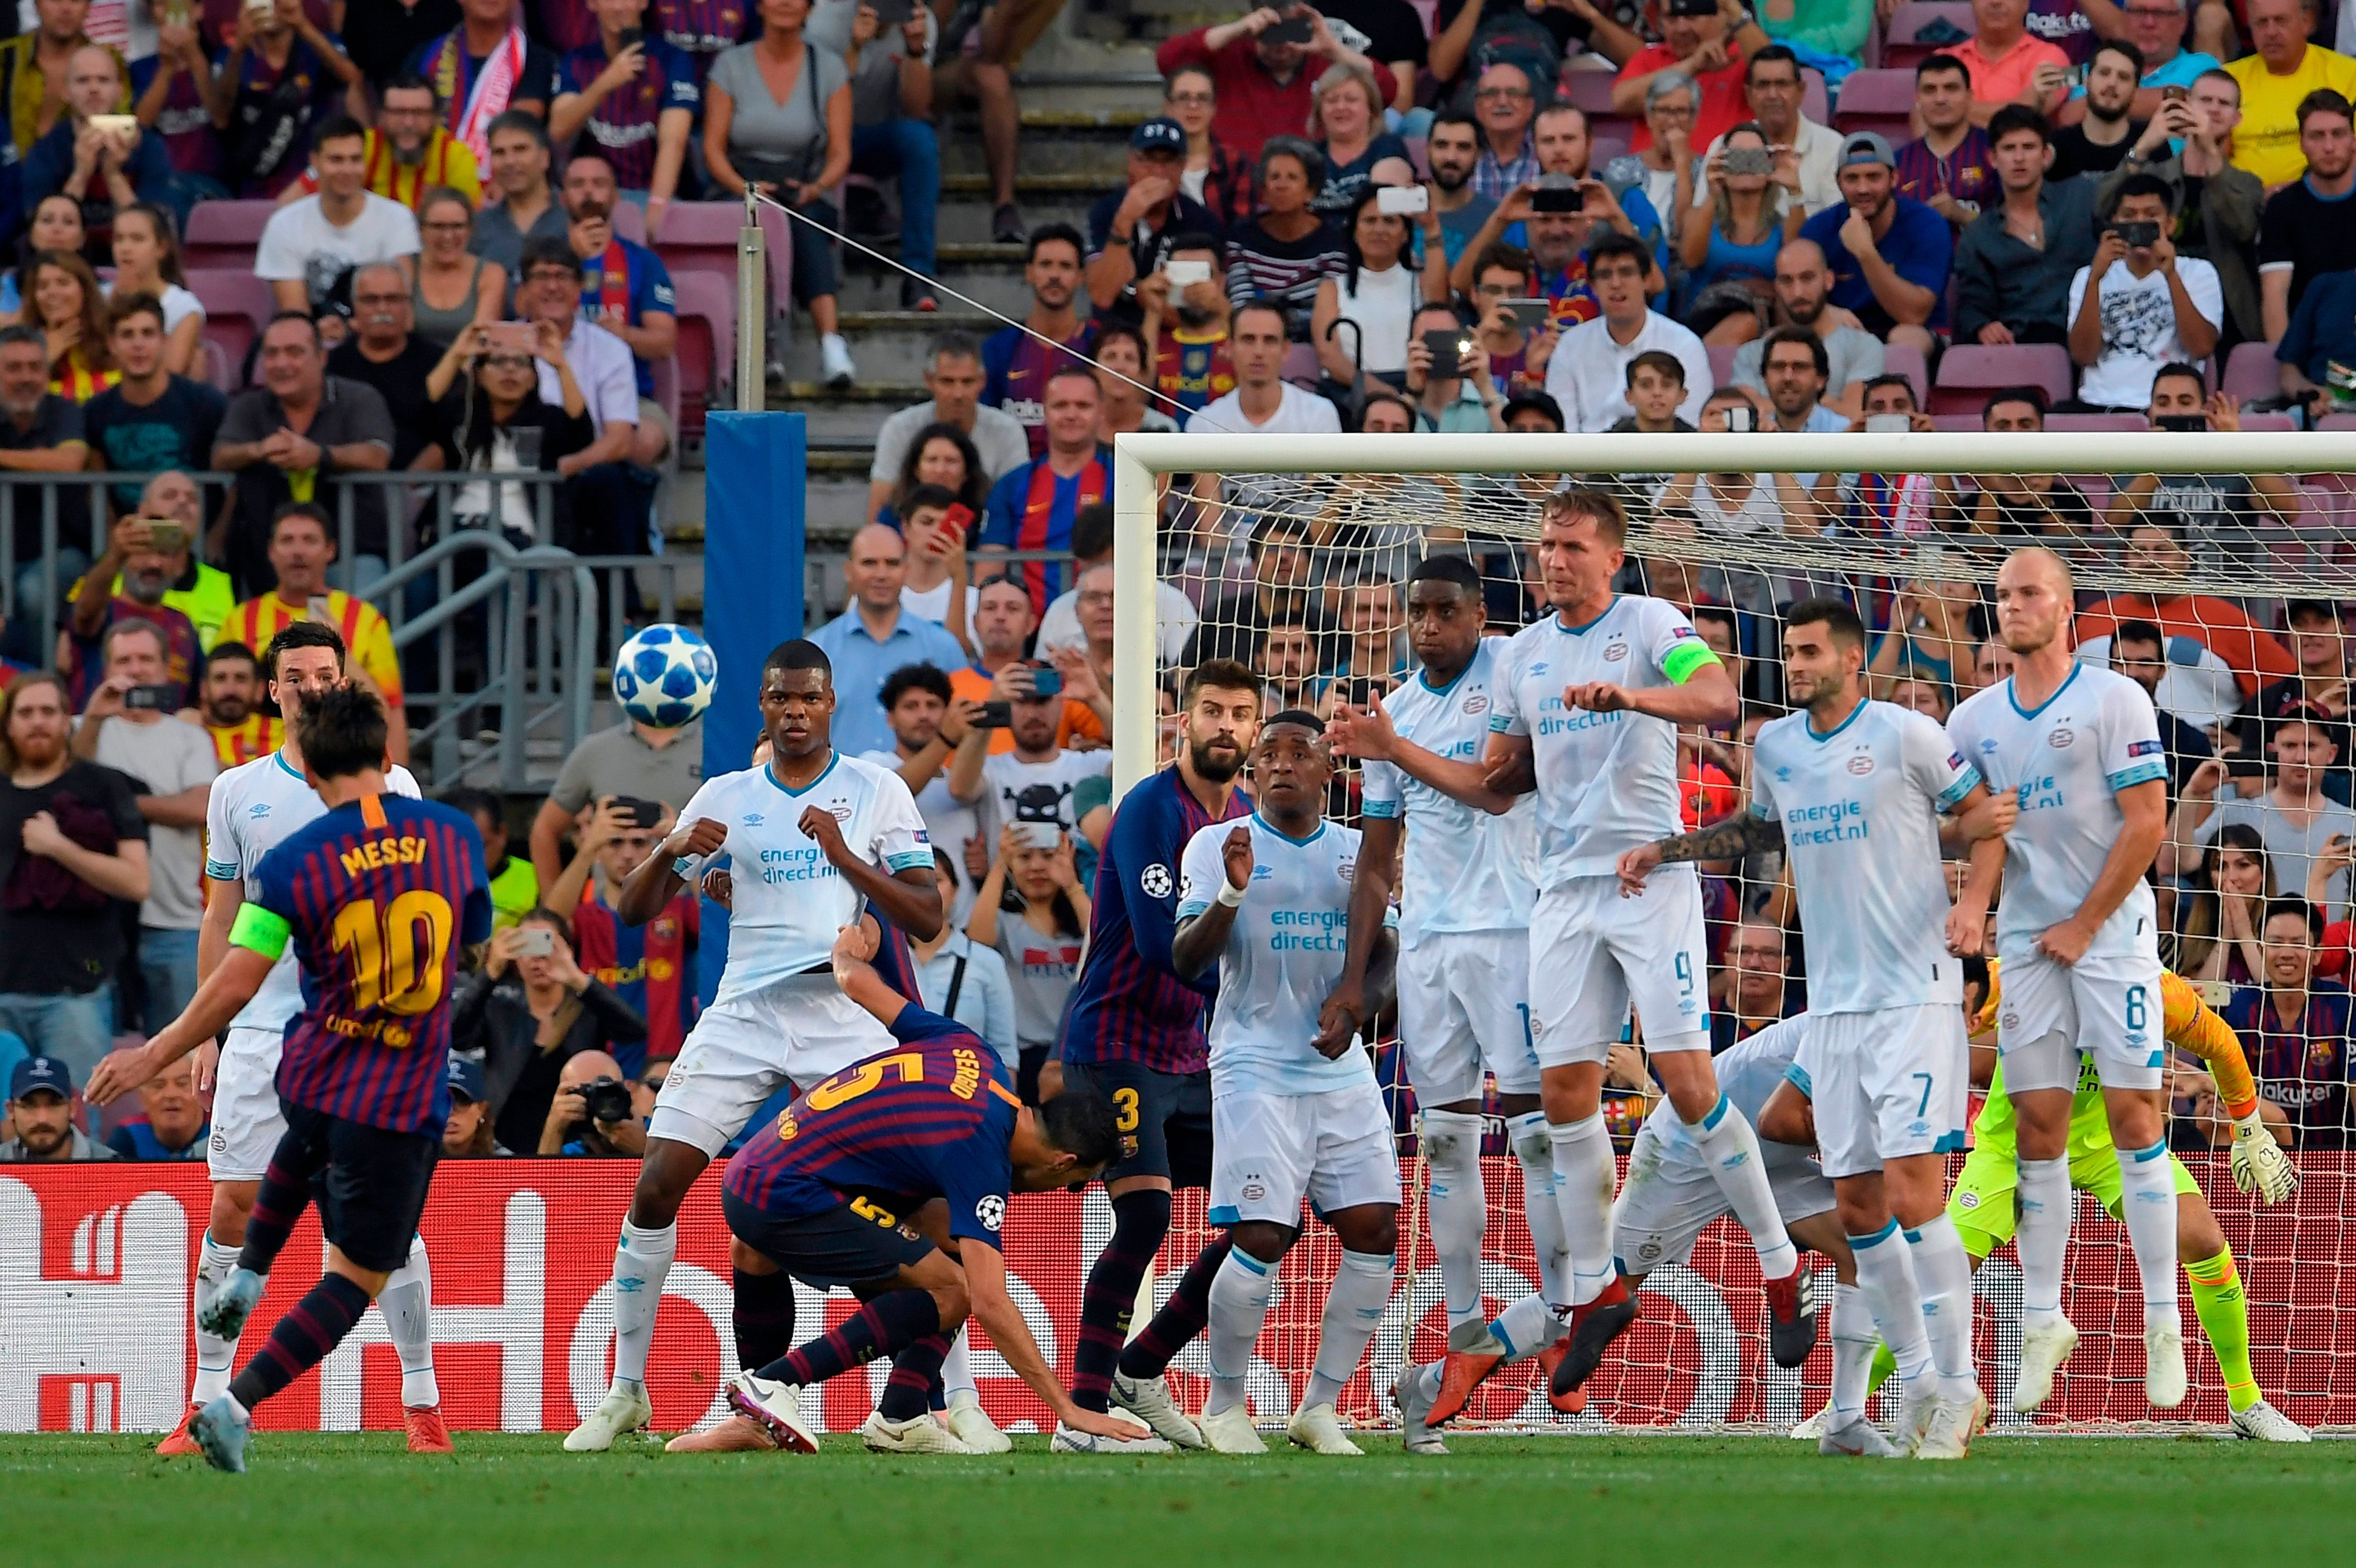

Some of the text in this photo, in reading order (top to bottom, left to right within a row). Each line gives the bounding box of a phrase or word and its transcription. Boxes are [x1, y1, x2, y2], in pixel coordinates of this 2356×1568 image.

[1789, 799, 1861, 823] energie
[1792, 820, 1867, 846] direct.nl
[340, 836, 427, 878] MESSI
[761, 848, 824, 863] energi
[1271, 908, 1347, 931] energie
[1271, 932, 1345, 952] direct.n
[332, 889, 454, 1016] 10
[1675, 951, 1694, 996] 9
[2127, 985, 2147, 1030] 8
[806, 1053, 924, 1111] 5
[950, 1048, 980, 1100] SERGIO
[1913, 1073, 1933, 1118] 7
[1112, 1087, 1139, 1132] 3
[850, 1196, 896, 1228] 5
[320, 1189, 2027, 1433] Hotescom
